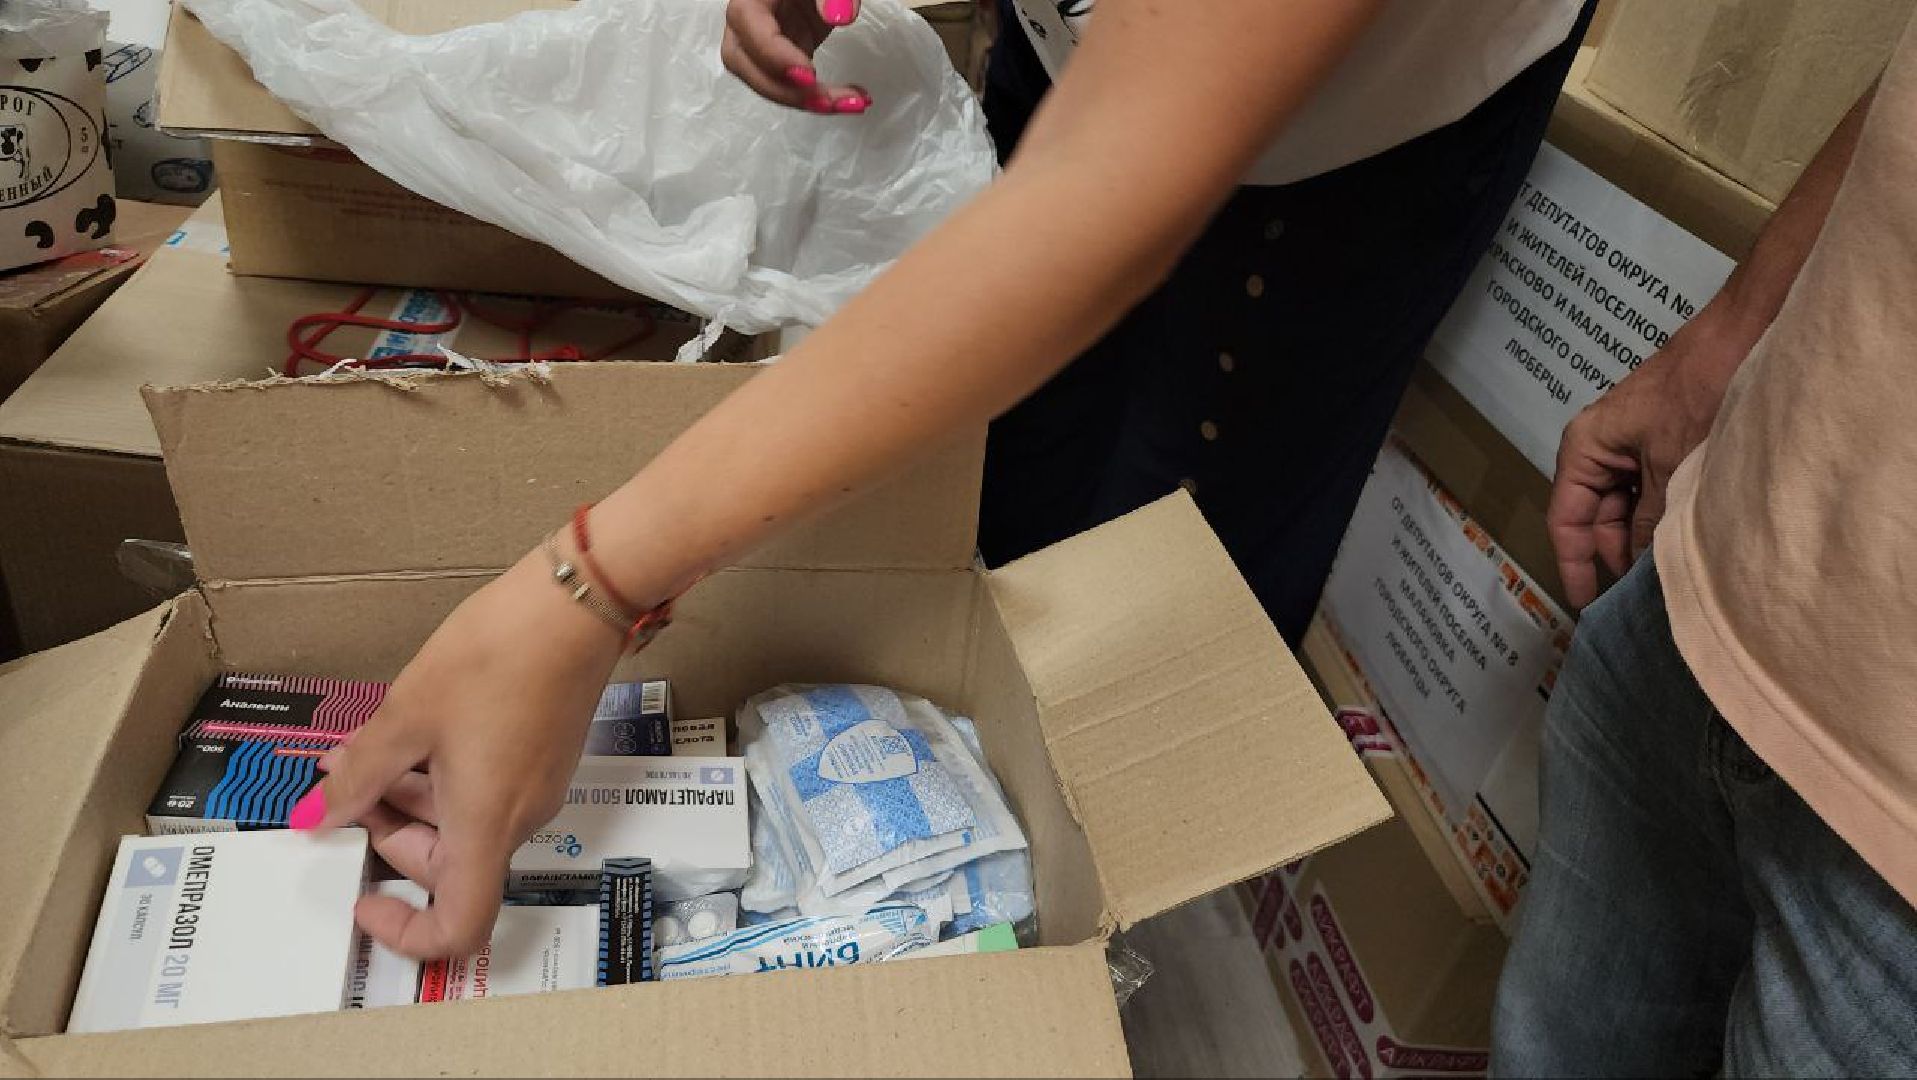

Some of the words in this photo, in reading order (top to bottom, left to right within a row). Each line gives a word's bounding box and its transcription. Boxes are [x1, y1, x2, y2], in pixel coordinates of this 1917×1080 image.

[1506, 217, 1518, 234] И
[1518, 226, 1585, 287] ЖИТЕЛЕЙ
[1524, 191, 1608, 257] ДЕПУТАТОВ
[1608, 250, 1669, 304] ОКРУГА
[1670, 293, 1695, 320] №
[1486, 279, 1570, 359] ГОРОДСКОГО
[1570, 354, 1616, 390] ОКРУ
[1554, 293, 1568, 312] И
[1567, 303, 1642, 370] МАЛАХОВ
[1504, 338, 1572, 404] ЛЮБЕРЦЫ
[1401, 514, 1454, 585] ДЕПУТАТОВ
[1452, 581, 1491, 636] ОКРУГА
[1439, 601, 1486, 669] ПОСЕЛКА
[590, 788, 621, 804] 500
[625, 788, 735, 806] ПАРАЦЕТАМОЛ
[168, 846, 215, 950] ОМЕПРАЗОЛ
[153, 981, 183, 1008] МГ
[162, 953, 189, 977] 20
